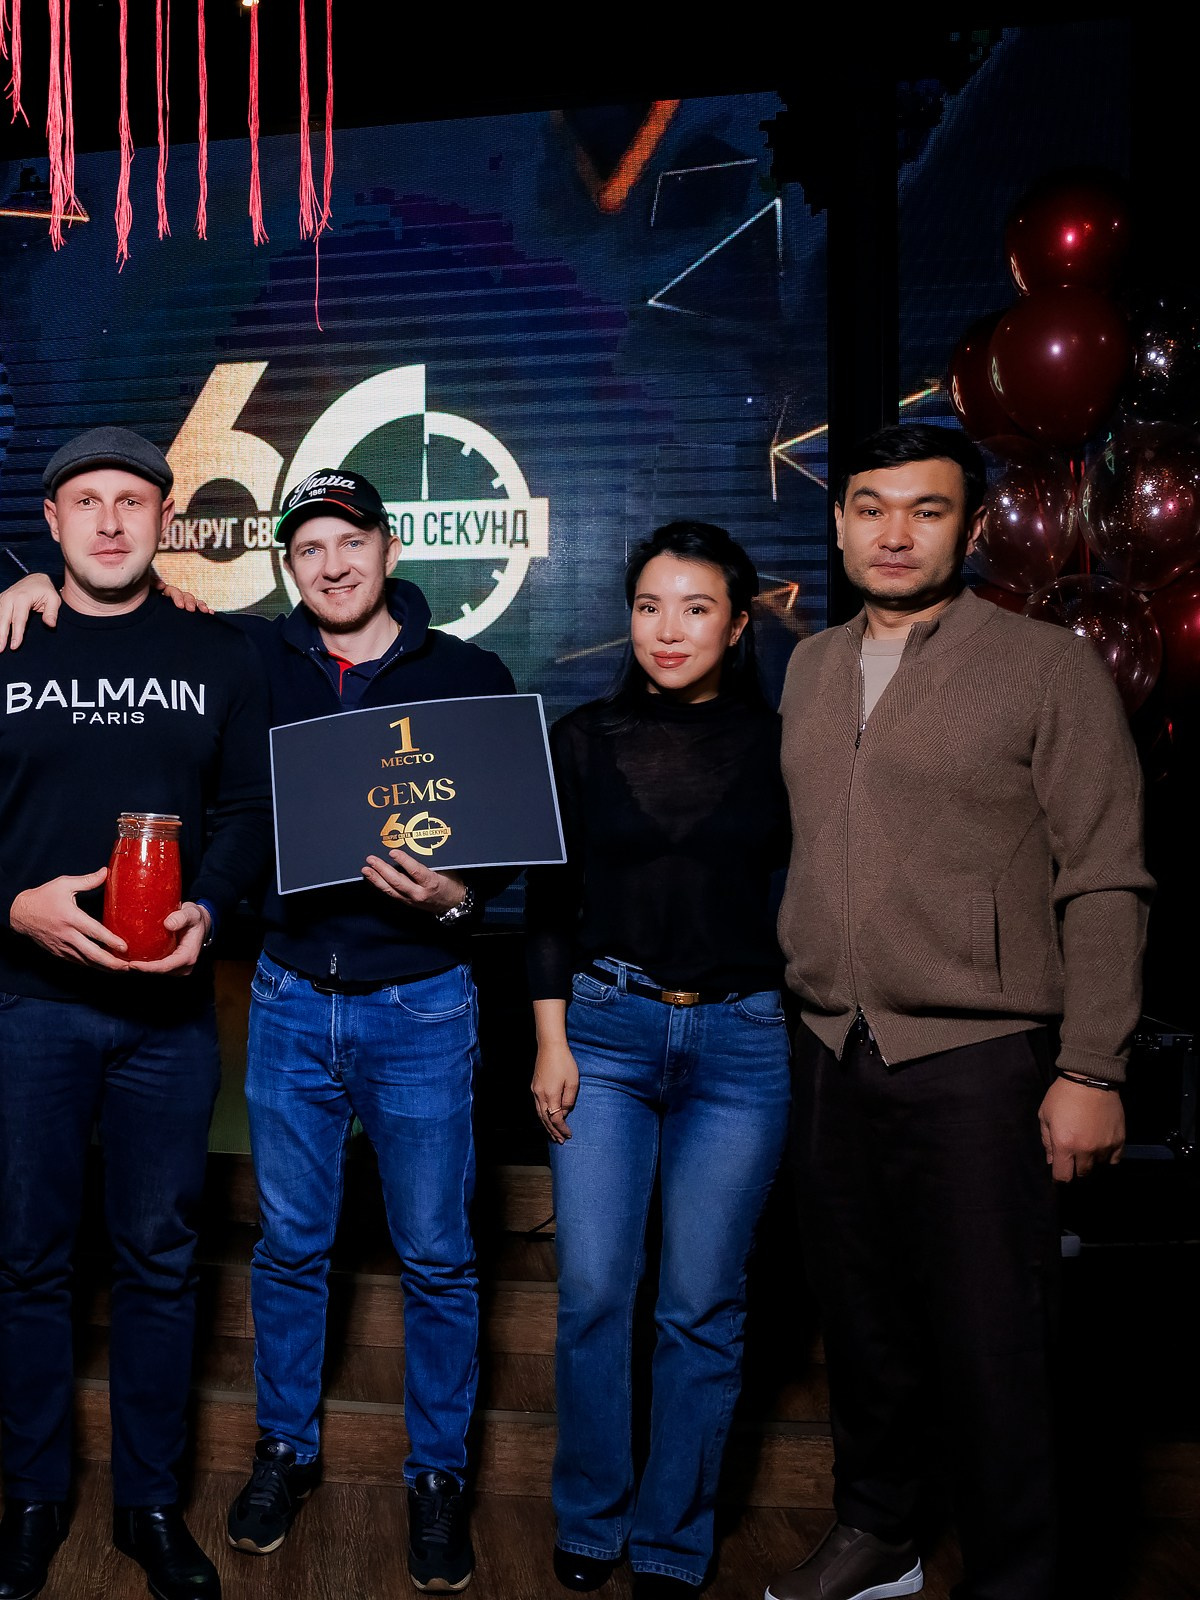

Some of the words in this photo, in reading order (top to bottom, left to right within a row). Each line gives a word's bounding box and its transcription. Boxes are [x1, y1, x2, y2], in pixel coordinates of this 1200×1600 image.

[424, 510, 529, 548] СЕКУНД
[6, 677, 205, 715] BALMAIN
[72, 711, 145, 725] PARIS
[389, 716, 420, 754] 1
[381, 752, 435, 768] МЕСТО
[367, 777, 456, 809] GEMS
